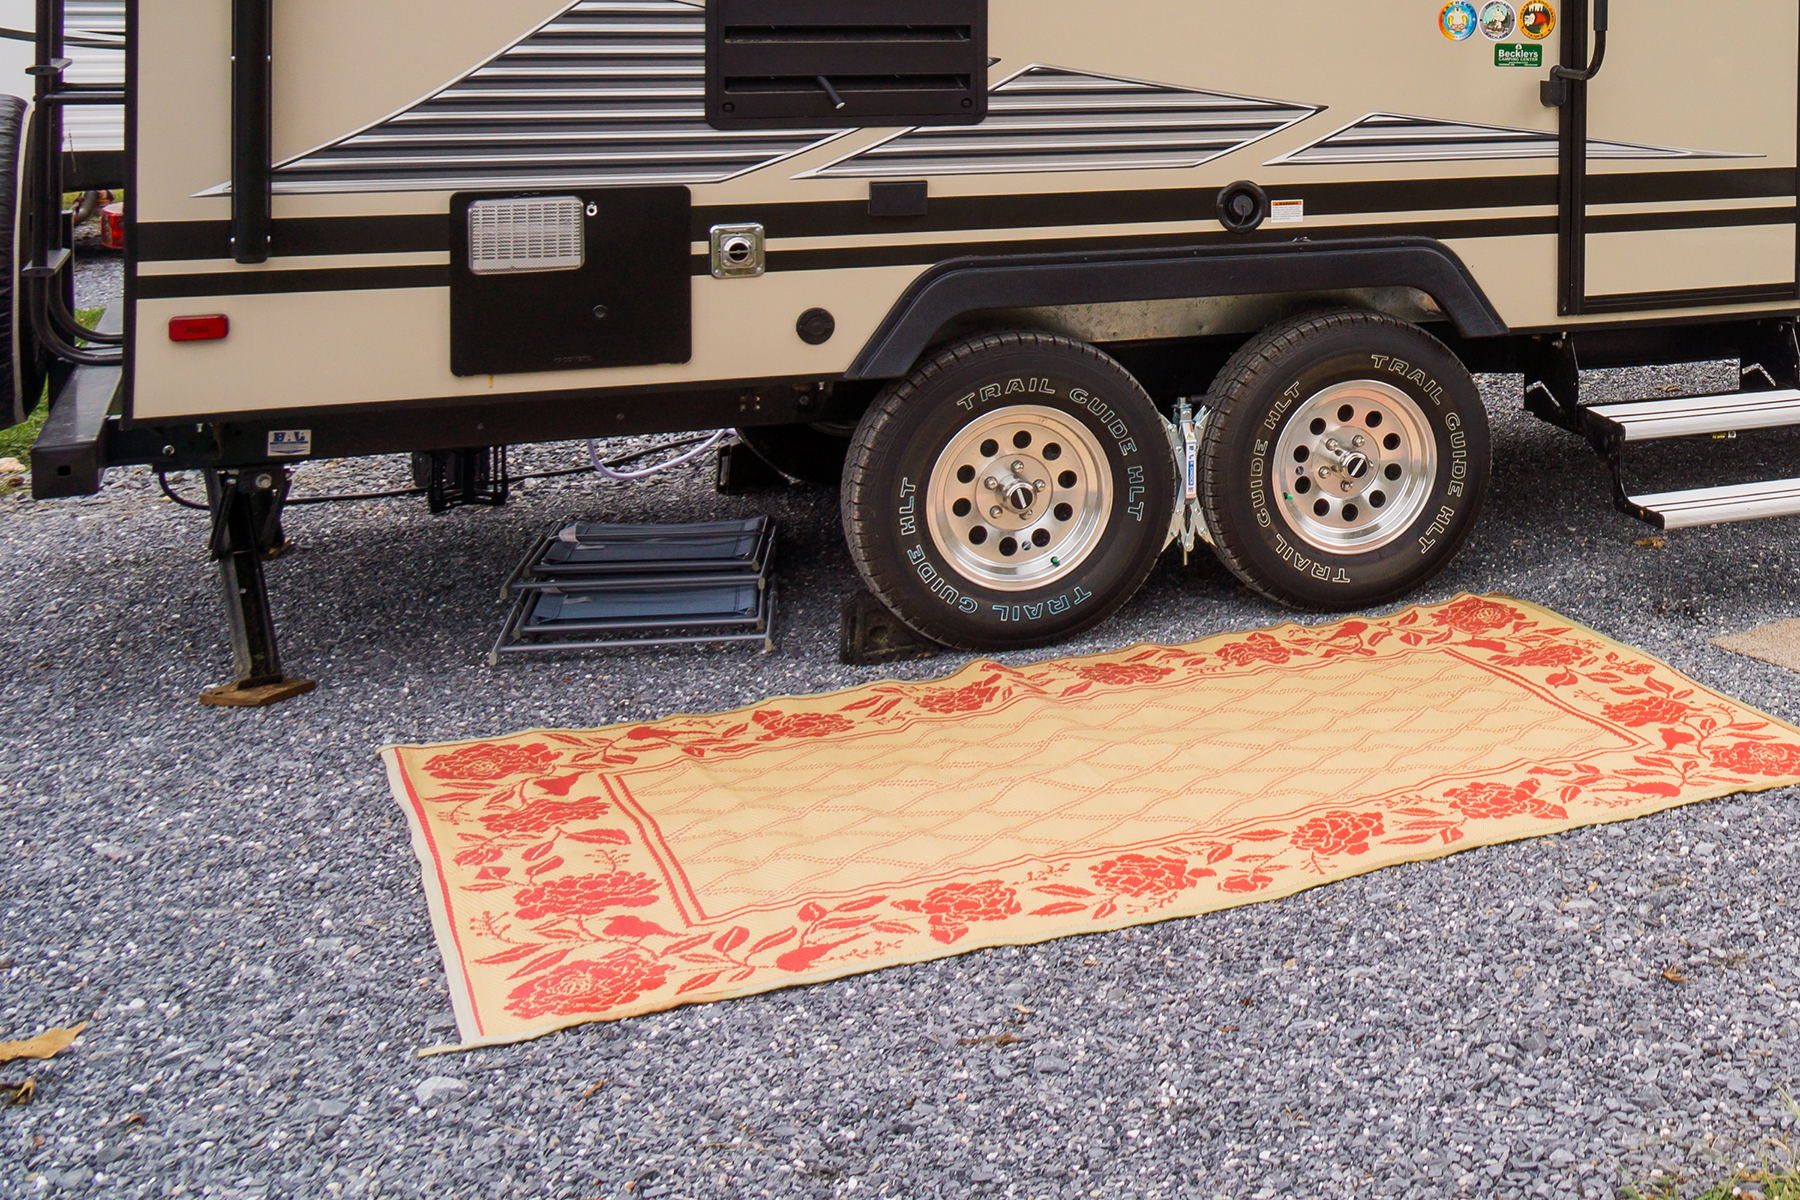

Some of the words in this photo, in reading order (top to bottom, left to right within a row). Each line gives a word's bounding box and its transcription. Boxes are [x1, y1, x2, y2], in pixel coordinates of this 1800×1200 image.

[1442, 1, 1474, 15] EXTREME
[1263, 381, 1302, 430] HLT
[1371, 354, 1442, 406] TRAIL
[957, 377, 1055, 411] TRAIL
[1069, 388, 1138, 456] GUIDE
[1127, 465, 1145, 522] HLT
[1445, 412, 1467, 497] GUIDE
[899, 477, 916, 536] HLT
[1250, 439, 1271, 528] GUIDE
[1418, 505, 1455, 554] HLT
[906, 544, 978, 613] GUIDE
[1275, 532, 1350, 583] TRAIL
[992, 586, 1092, 622] TRAIL
